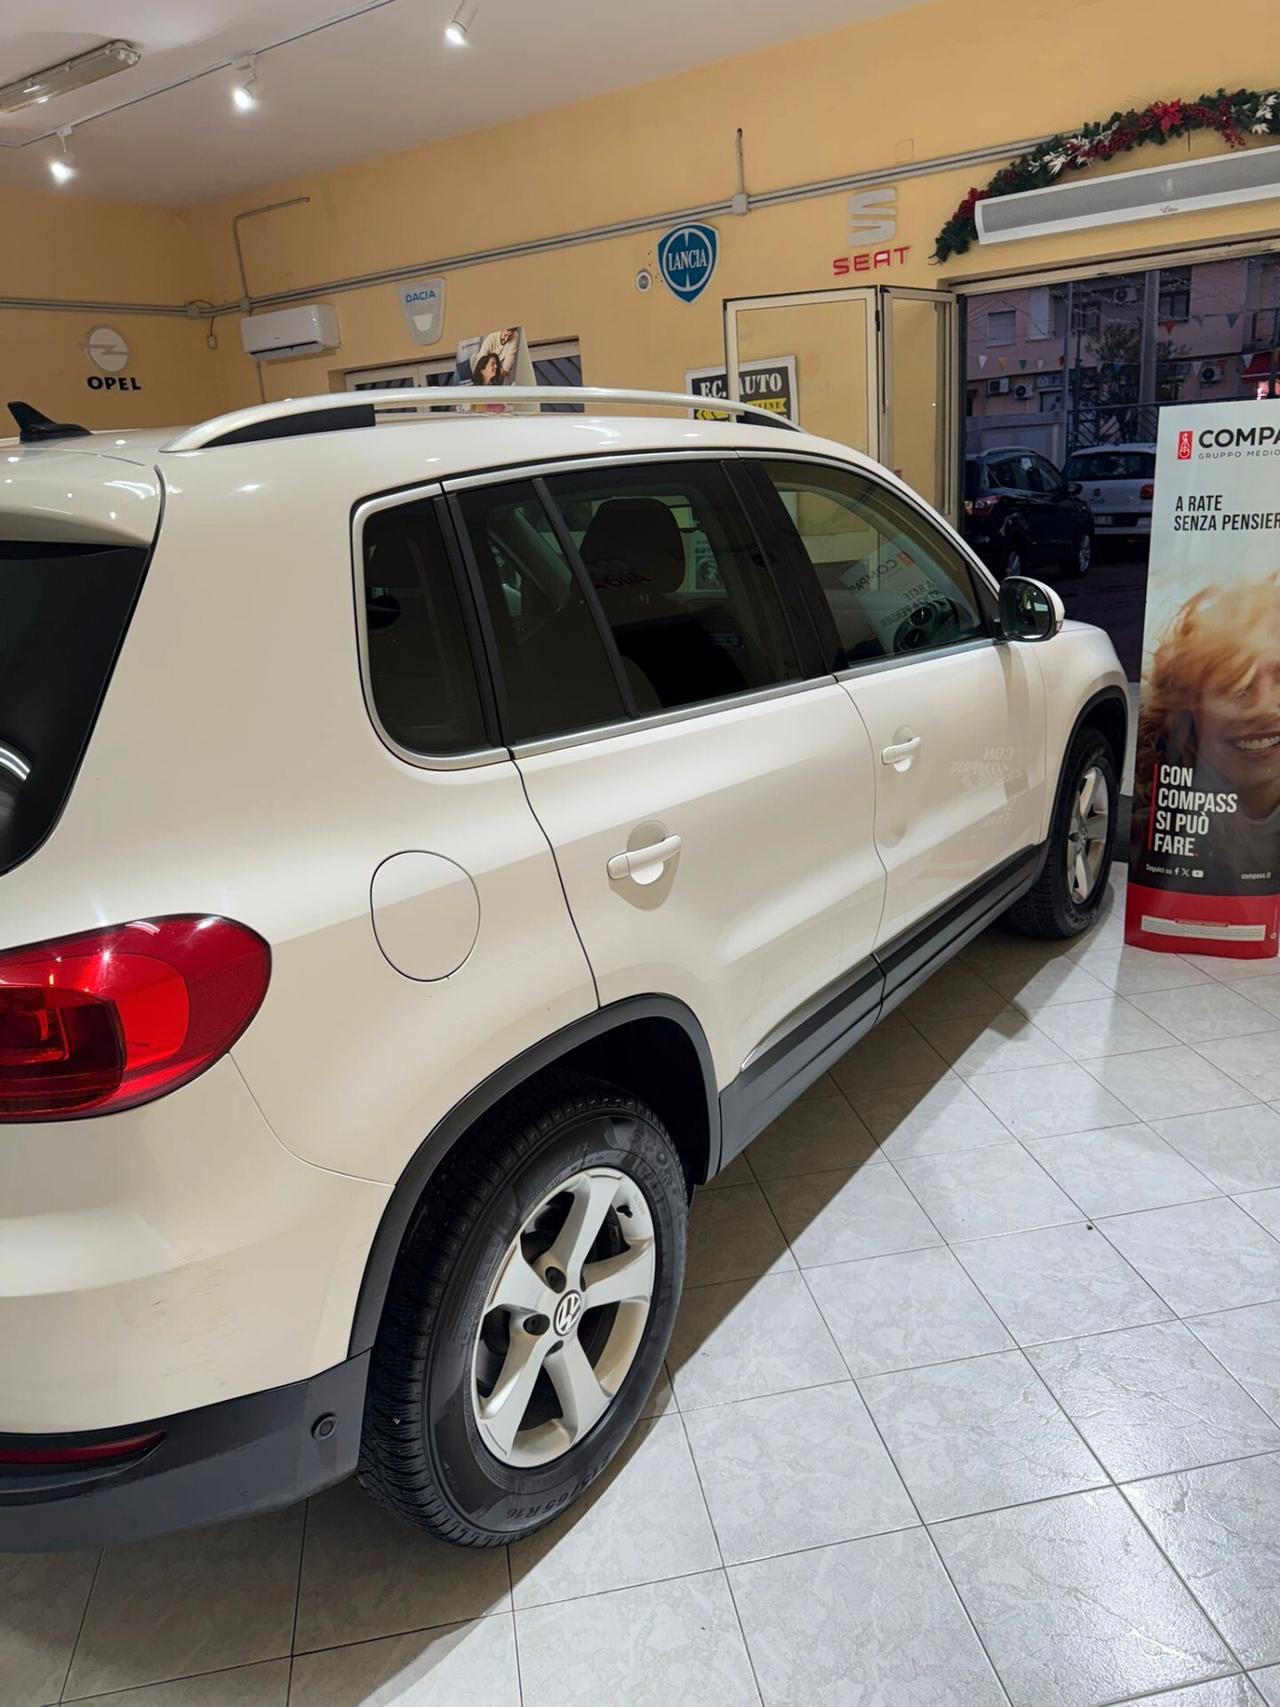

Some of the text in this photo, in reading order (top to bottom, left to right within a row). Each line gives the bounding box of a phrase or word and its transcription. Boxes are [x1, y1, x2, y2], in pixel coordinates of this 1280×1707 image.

[668, 248, 709, 271] LANCIA
[833, 246, 910, 276] SEAT
[405, 290, 436, 303] DACIA
[87, 376, 142, 391] OPEL
[1199, 451, 1241, 460] GRUPPO
[1175, 494, 1223, 512] A RATE
[1174, 513, 1280, 532] SENZA PENSIER
[1160, 765, 1193, 787] CON
[1158, 788, 1237, 812] COMPASS
[1155, 810, 1209, 835] SI PUÒ
[1154, 833, 1199, 857] FARE.
[1241, 871, 1272, 881] compass.it
